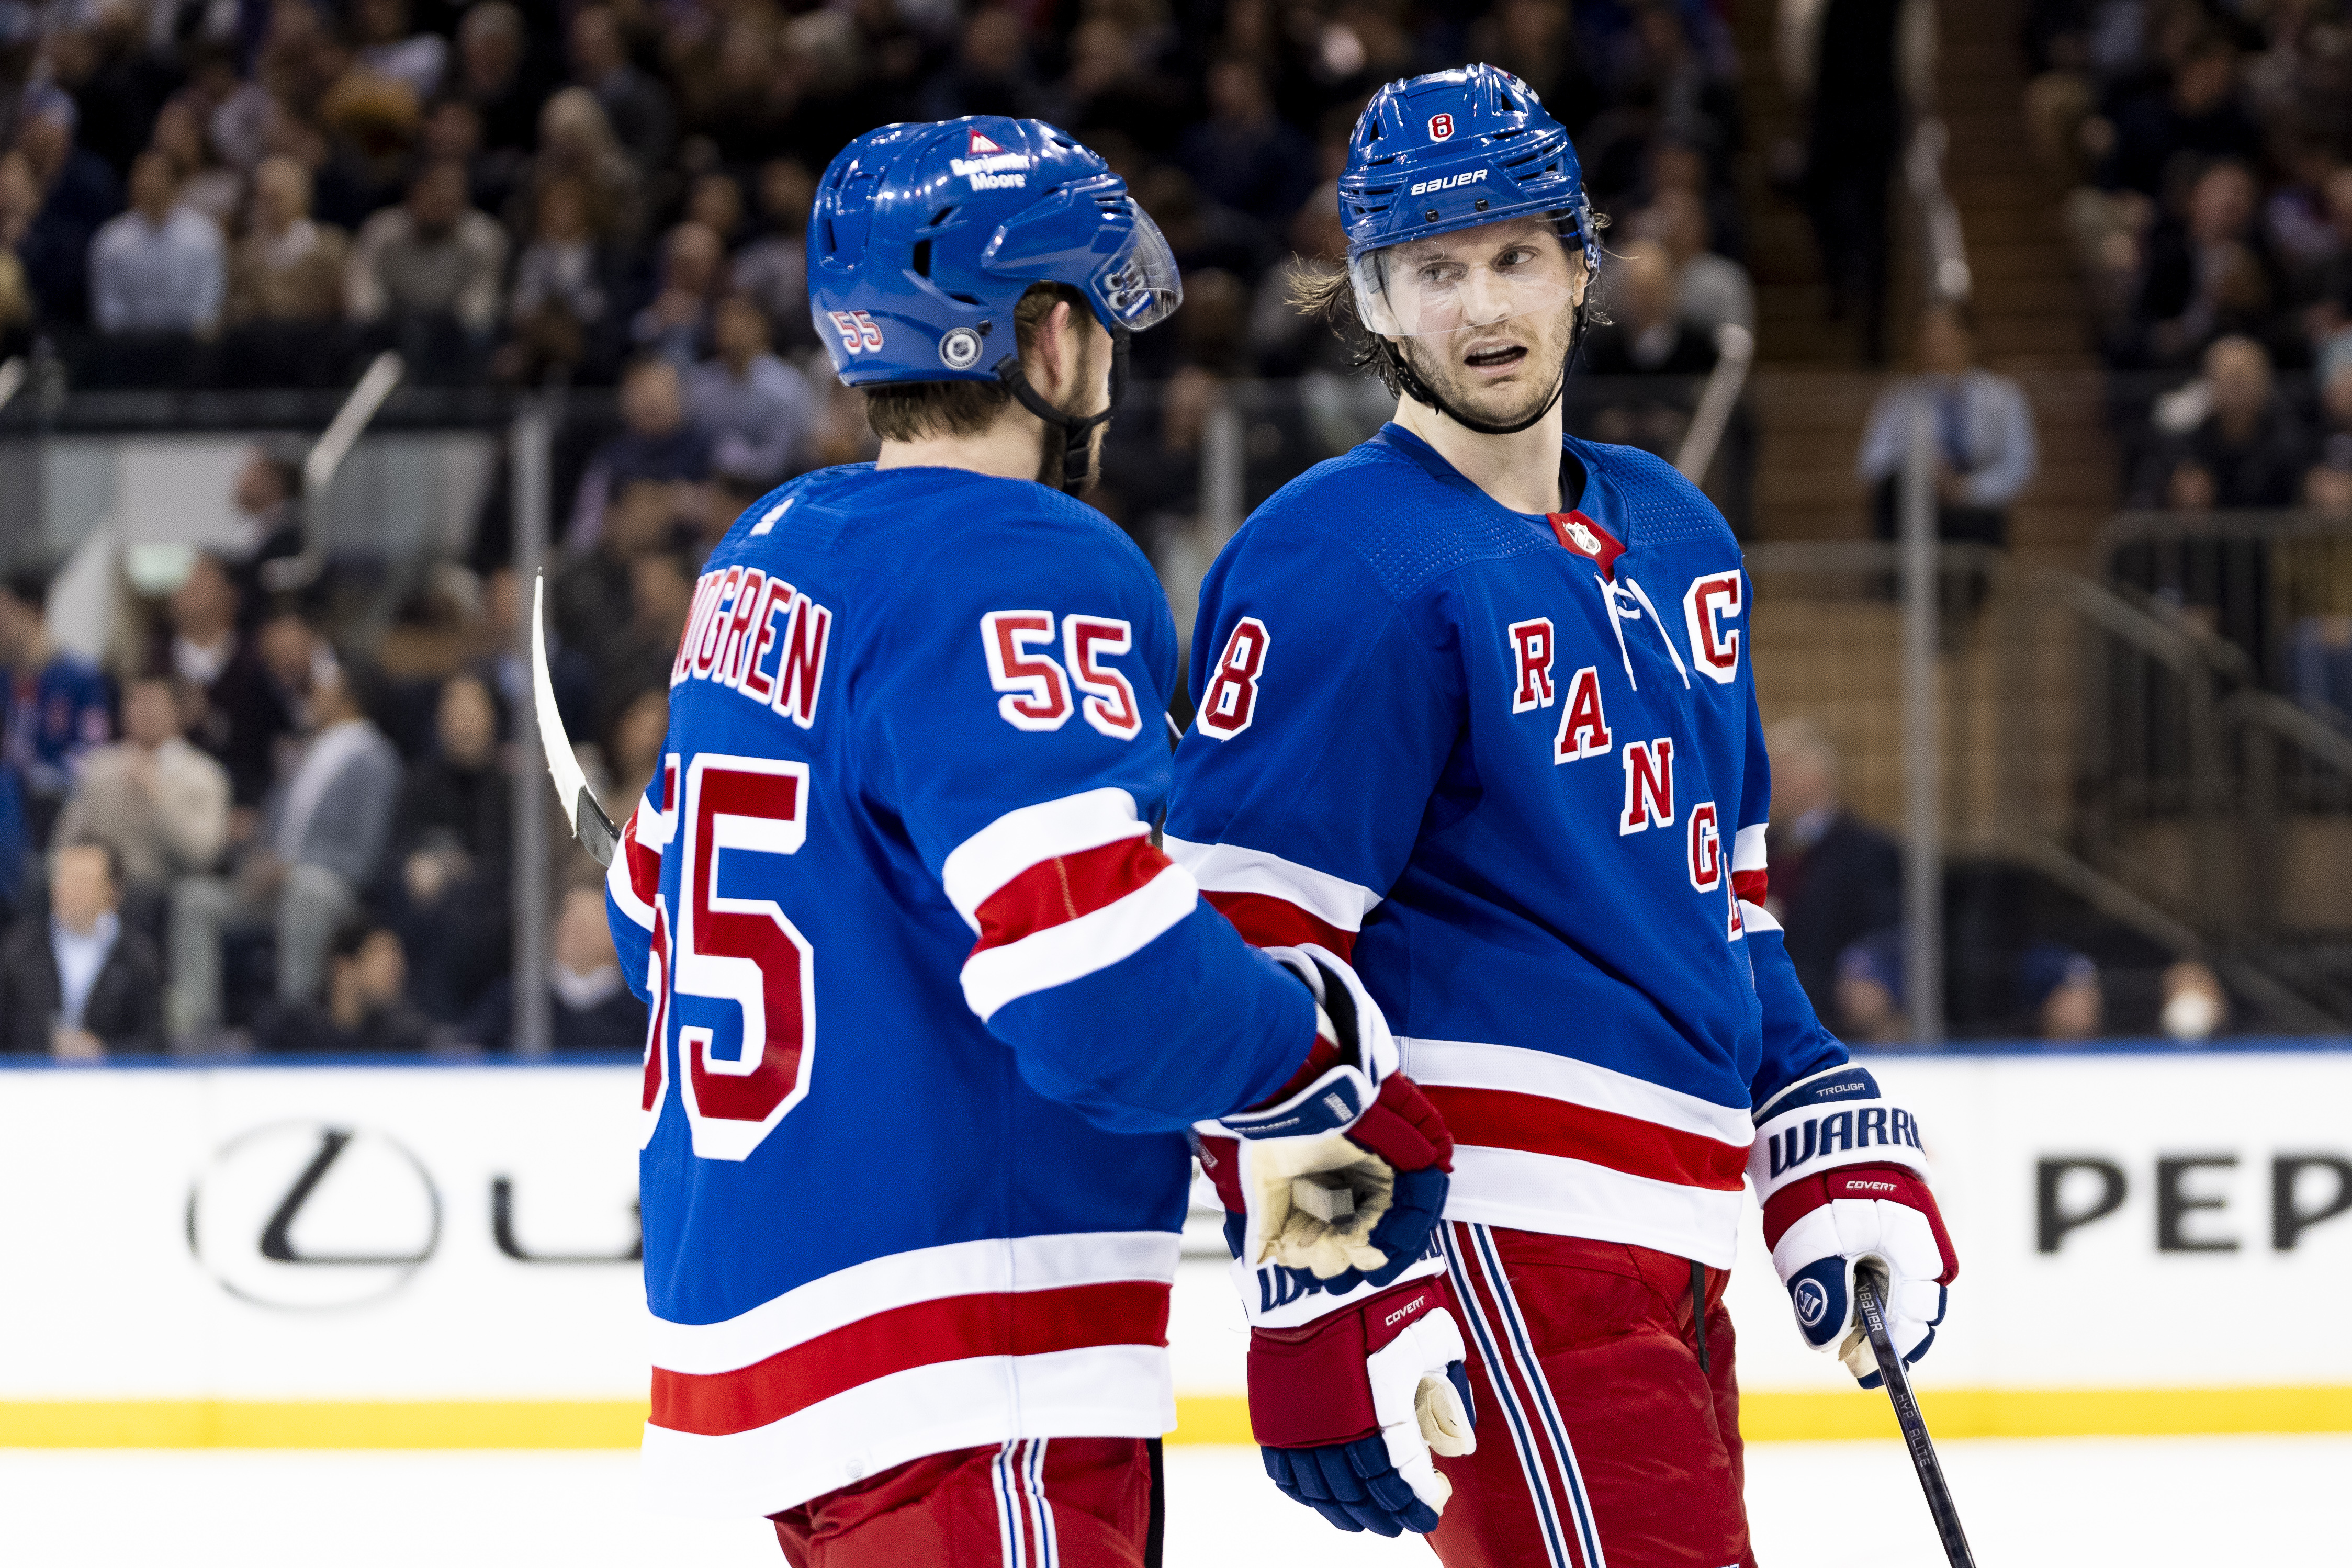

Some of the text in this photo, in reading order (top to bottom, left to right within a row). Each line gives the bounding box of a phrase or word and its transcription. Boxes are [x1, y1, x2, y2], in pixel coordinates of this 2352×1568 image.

[1428, 113, 1455, 142] 8
[950, 153, 1030, 177] Benjamin
[970, 172, 1026, 192] Moore
[1411, 168, 1488, 196] BAUER
[827, 309, 884, 354] 55
[1684, 569, 1741, 684] C
[980, 609, 1143, 742] 55
[1196, 616, 1271, 741] 8
[1845, 1180, 1897, 1192] COVERT
[2034, 1153, 2352, 1256] PEP
[1385, 1295, 1424, 1327] COVERT
[1859, 1292, 1883, 1333] BAUER
[1897, 1392, 1931, 1468] HYPRLITE
